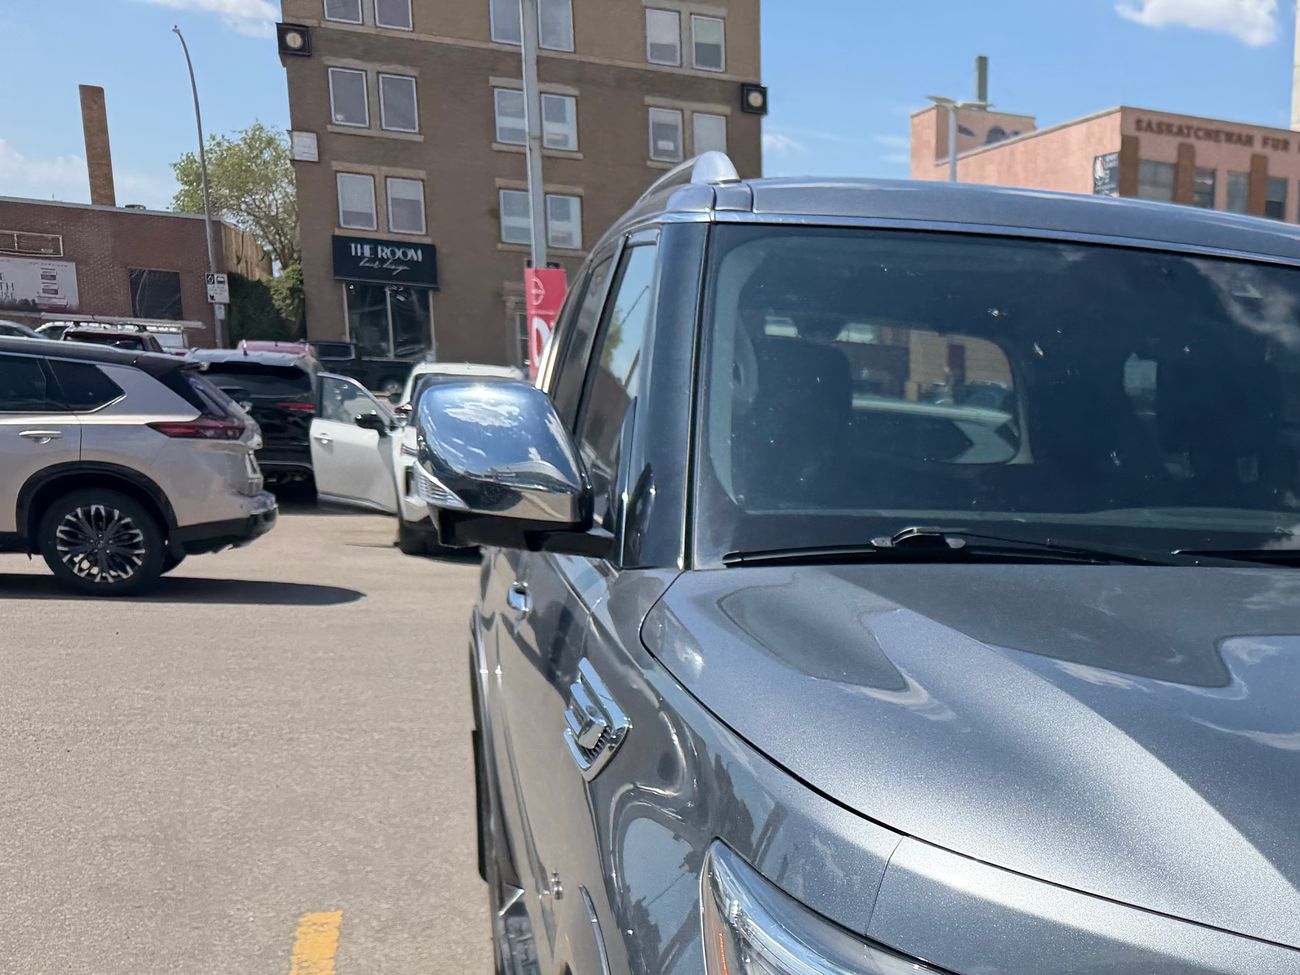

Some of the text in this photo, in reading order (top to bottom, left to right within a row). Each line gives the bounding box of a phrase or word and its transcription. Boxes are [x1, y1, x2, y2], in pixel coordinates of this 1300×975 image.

[1134, 118, 1254, 148] SASKATCHEWAN
[1262, 136, 1290, 152] FUR
[350, 243, 422, 262] THE ROOM
